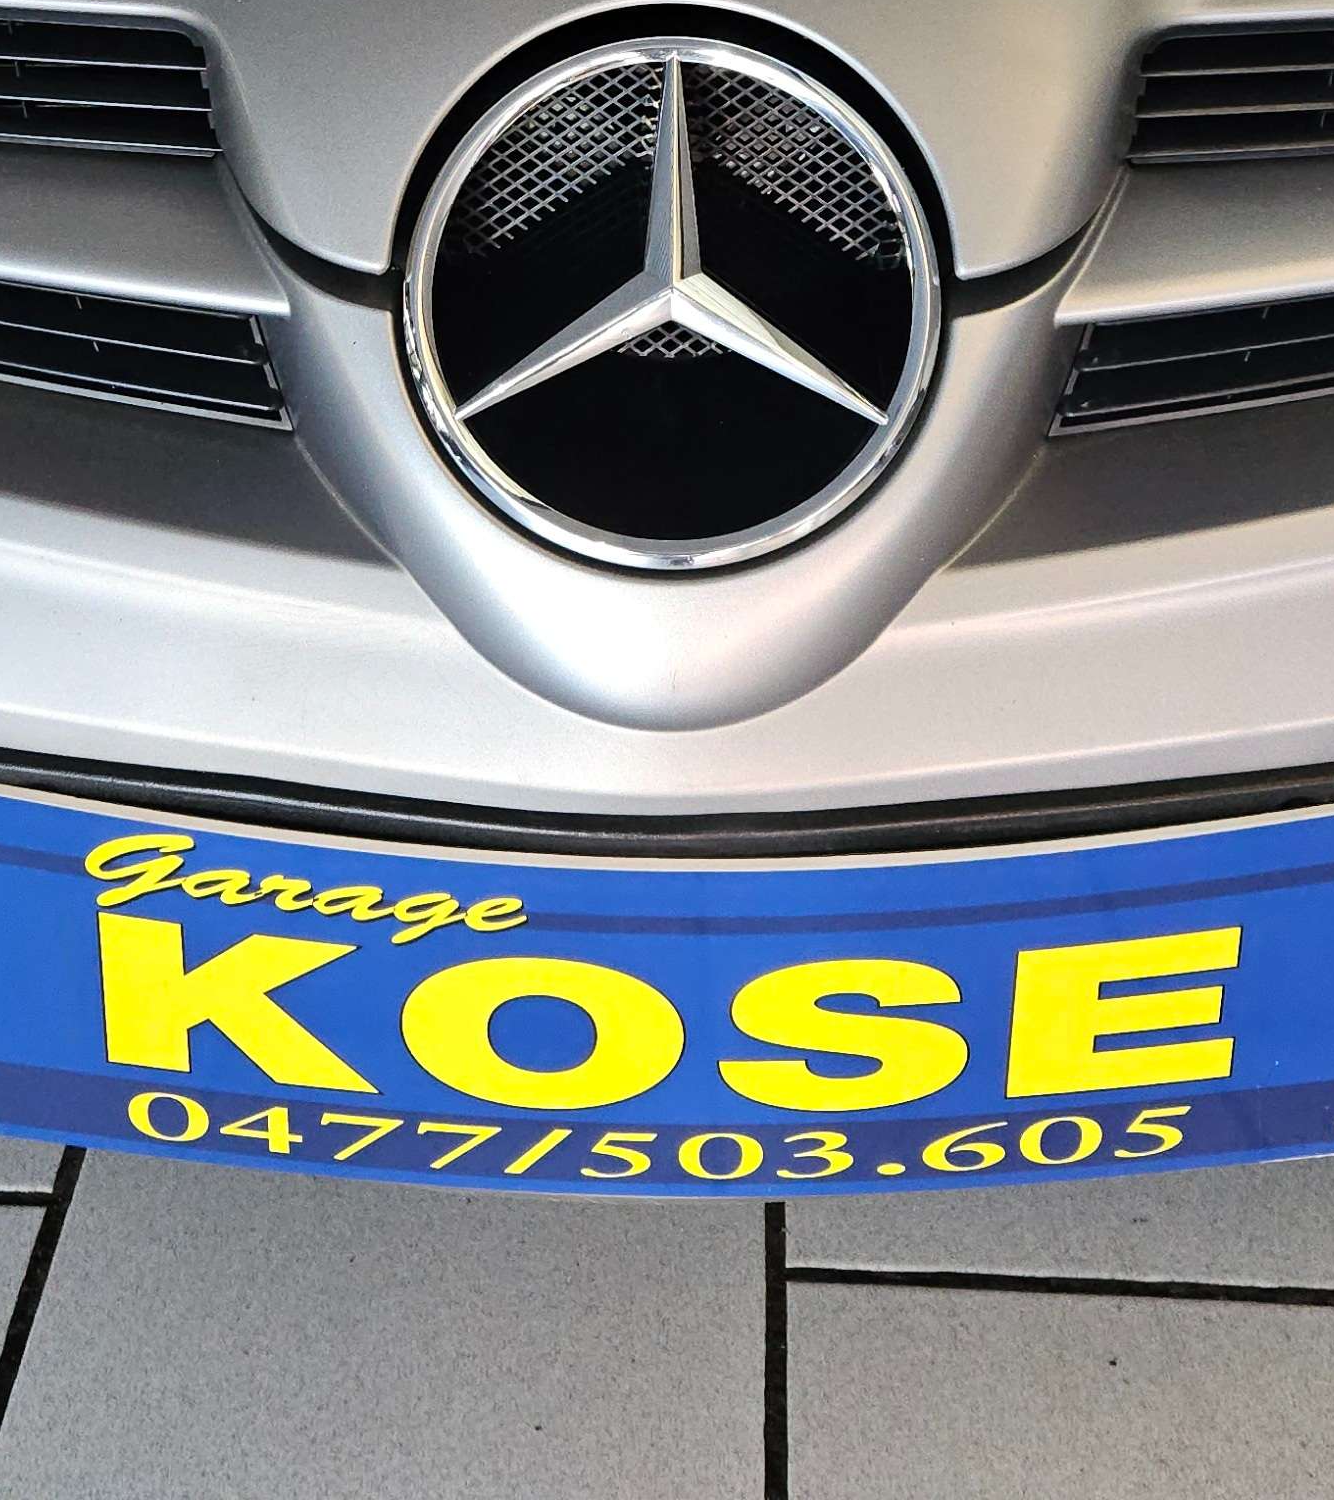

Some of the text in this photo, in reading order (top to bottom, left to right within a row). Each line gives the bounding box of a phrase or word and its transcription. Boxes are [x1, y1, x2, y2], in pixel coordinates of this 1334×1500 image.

[83, 833, 527, 944] Garage
[97, 911, 1243, 1112] KOSE
[126, 1090, 1189, 1179] 0477/503.605
